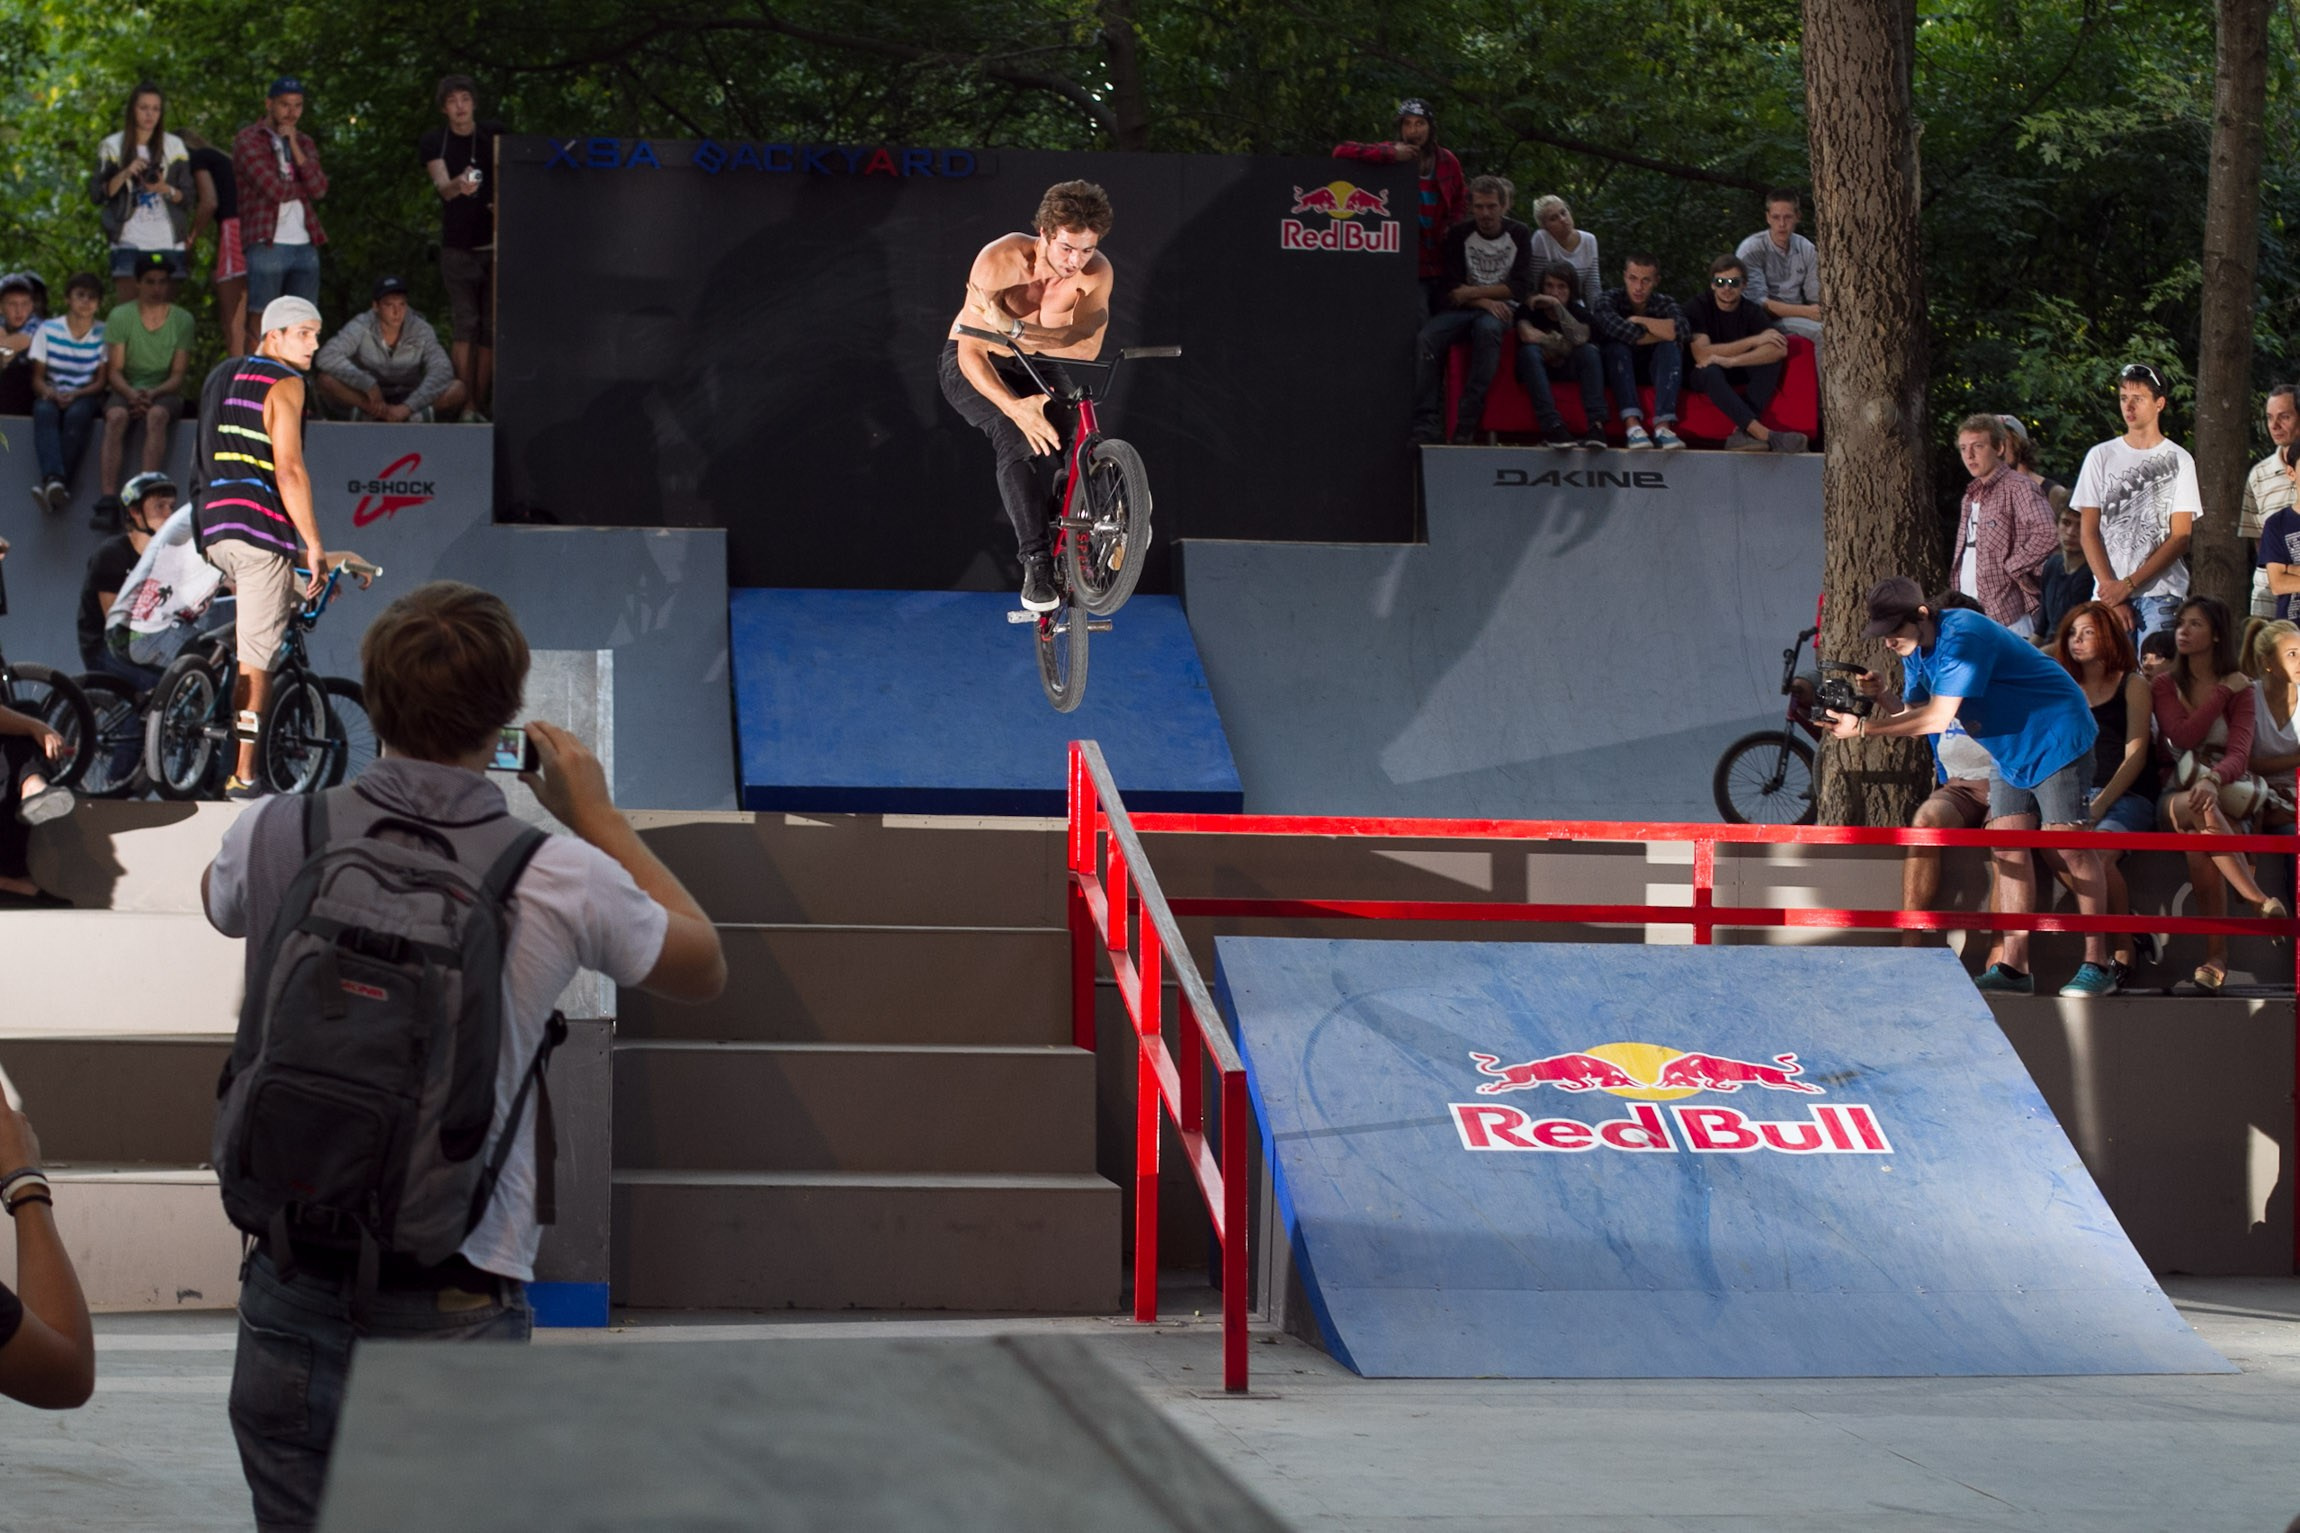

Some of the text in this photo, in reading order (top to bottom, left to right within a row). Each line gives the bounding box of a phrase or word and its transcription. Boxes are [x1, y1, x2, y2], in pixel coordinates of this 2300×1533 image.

[545, 137, 976, 178] XSA BACKYARD
[1281, 219, 1400, 253] Red Bull
[347, 480, 436, 495] G-SHOCK
[1448, 1103, 1894, 1154] Red Bull
